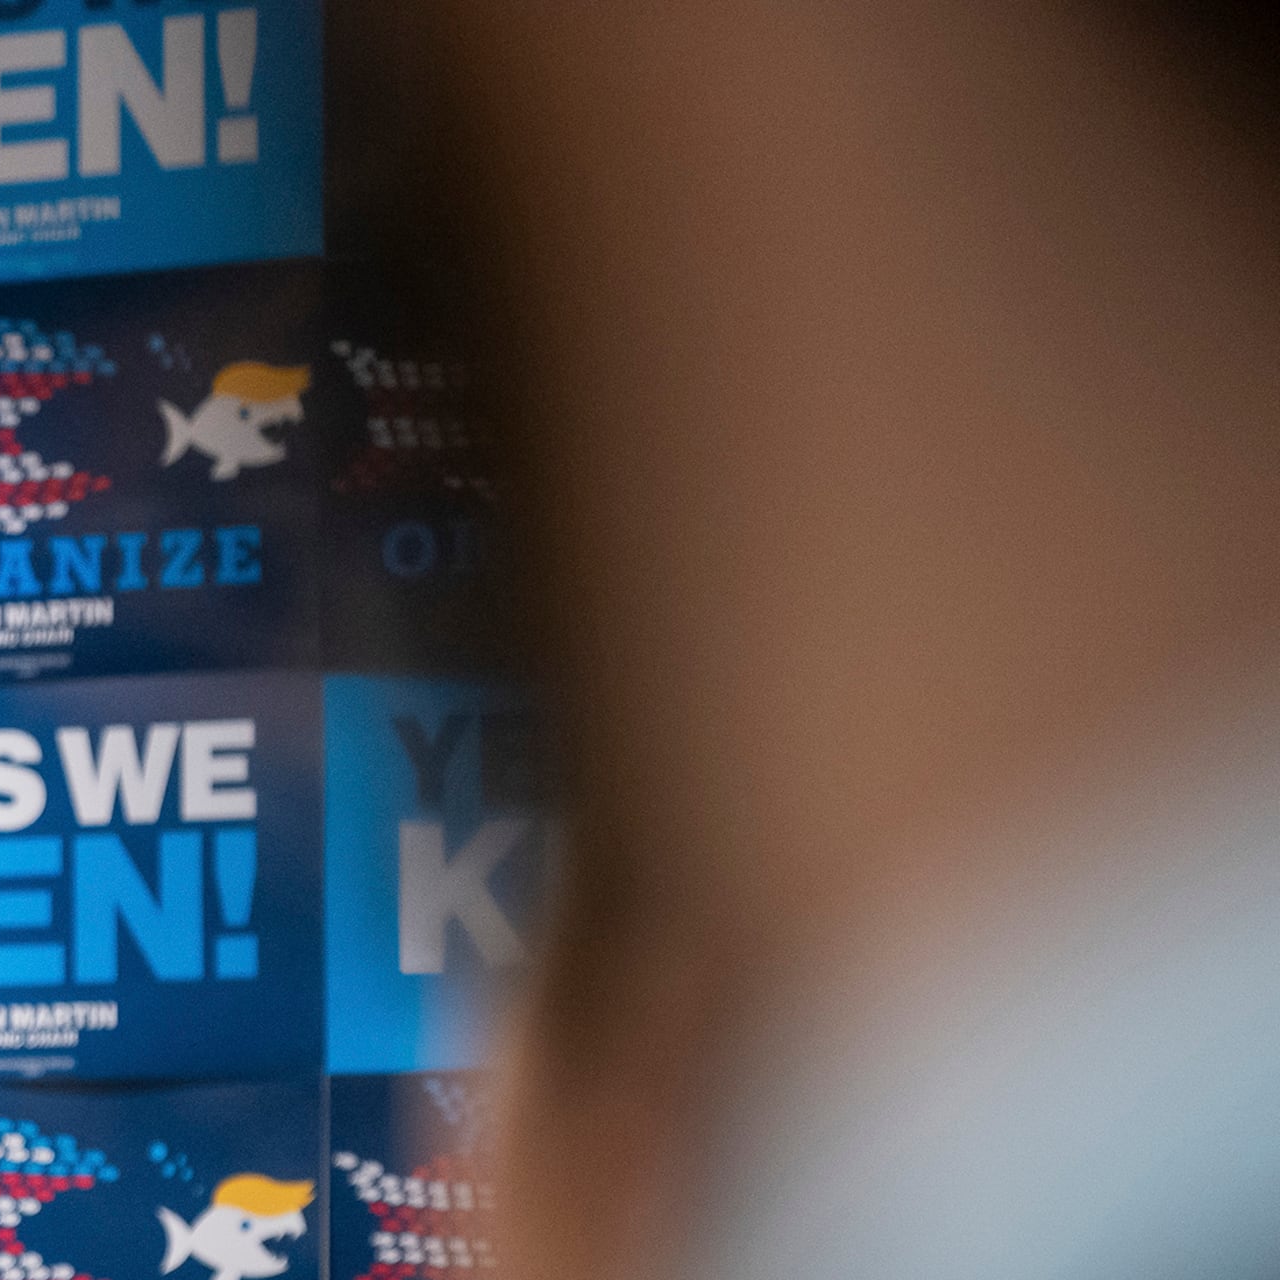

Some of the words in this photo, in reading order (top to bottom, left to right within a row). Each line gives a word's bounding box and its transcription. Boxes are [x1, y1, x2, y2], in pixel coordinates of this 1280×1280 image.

[3, 597, 114, 631] MARTIN
[56, 718, 257, 827] WE
[9, 1001, 118, 1032] MARTIN
